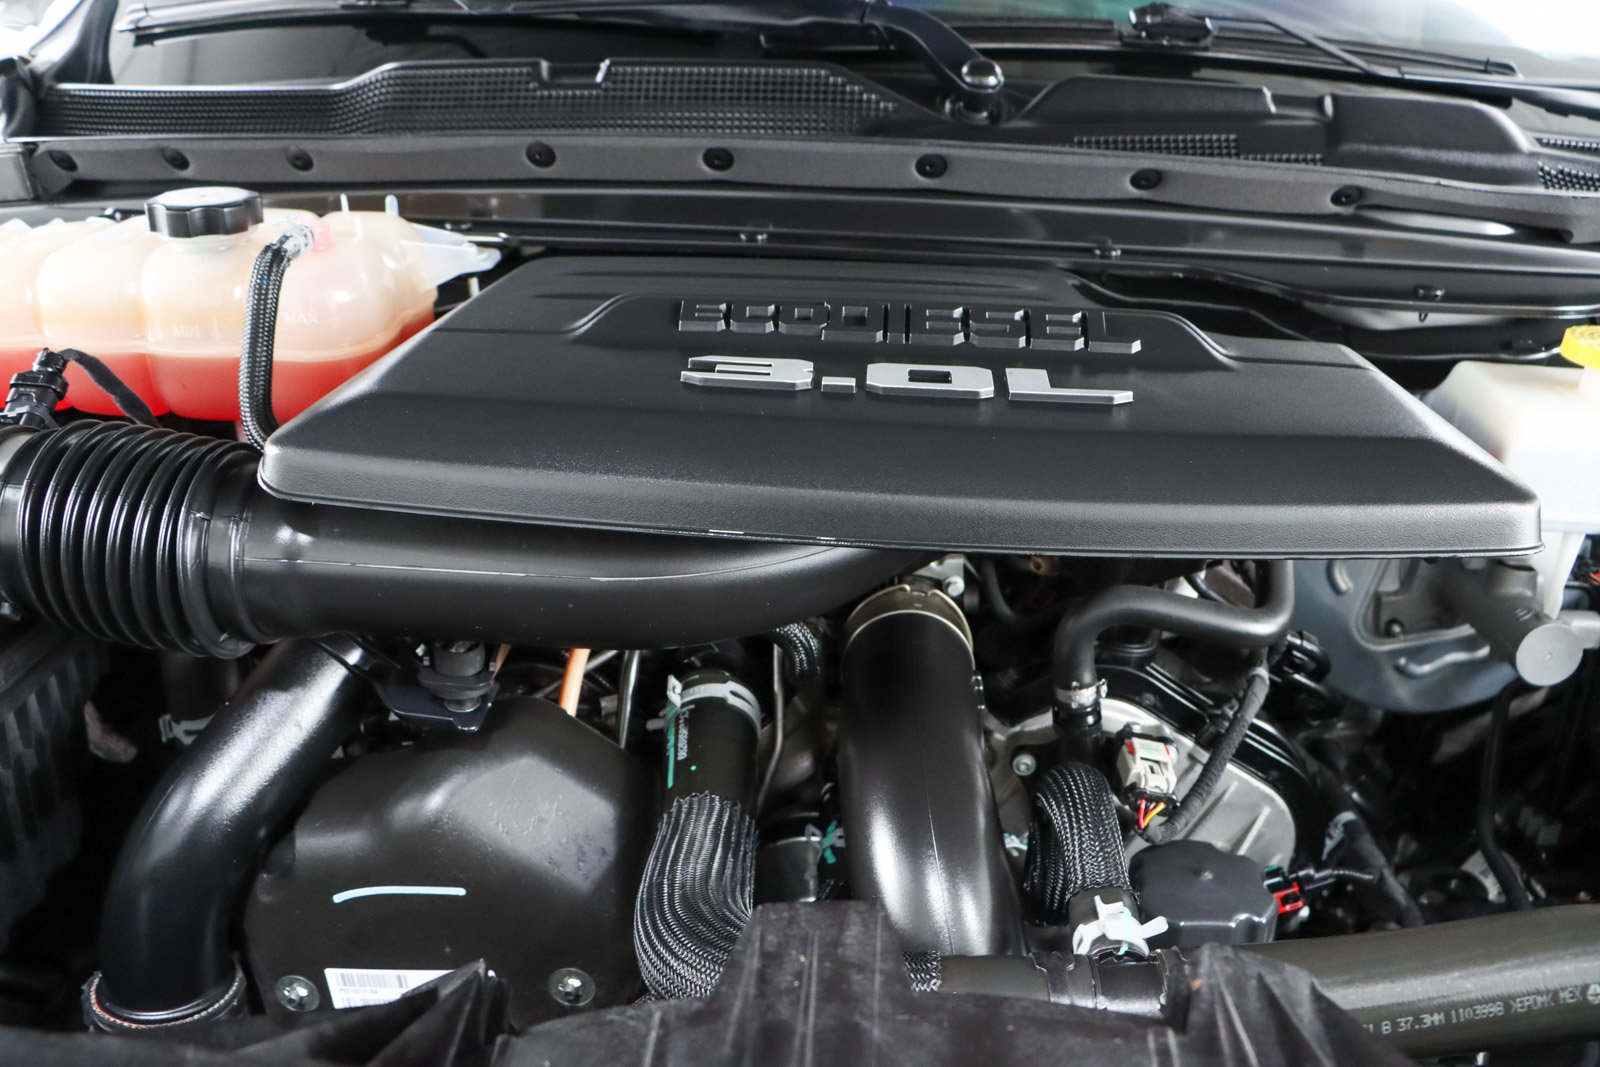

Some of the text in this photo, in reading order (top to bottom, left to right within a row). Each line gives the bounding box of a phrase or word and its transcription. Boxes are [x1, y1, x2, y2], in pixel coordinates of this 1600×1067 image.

[170, 322, 201, 339] MIN
[283, 311, 320, 325] MAX
[679, 299, 1141, 354] ECODIESEL
[680, 354, 1134, 404] 3.0L
[1396, 1012, 1446, 1033] 37.3MM
[1559, 985, 1583, 1006] MEX
